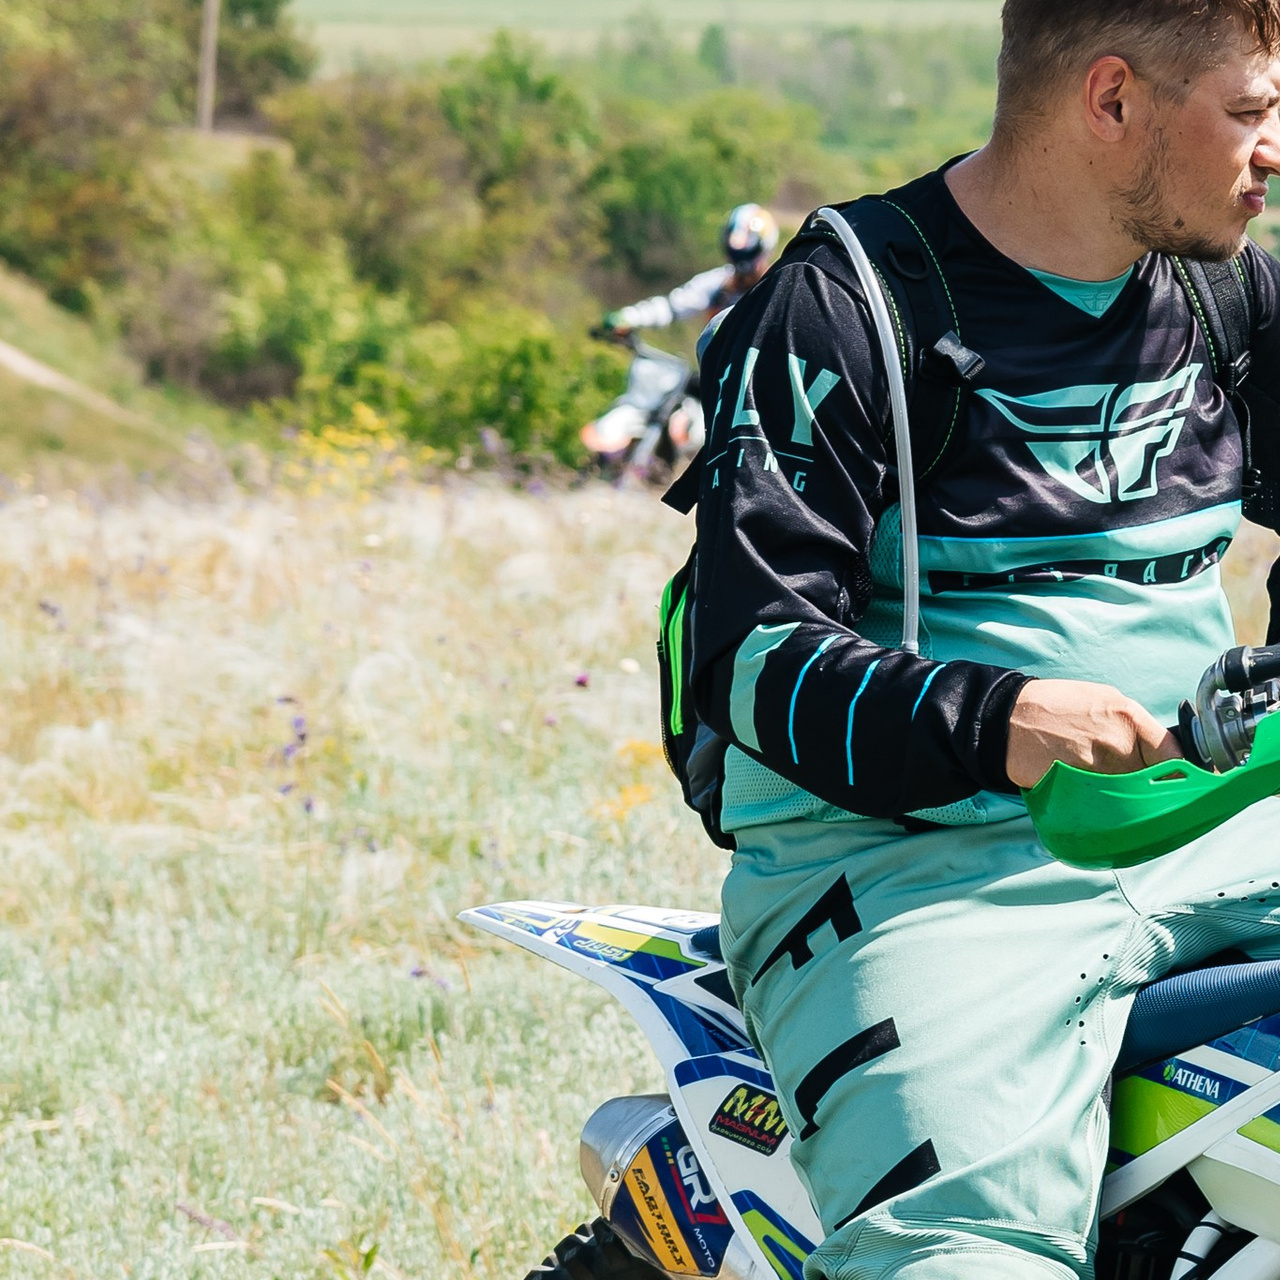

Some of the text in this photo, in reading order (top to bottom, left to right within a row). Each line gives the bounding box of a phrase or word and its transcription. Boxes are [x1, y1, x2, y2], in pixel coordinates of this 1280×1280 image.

[711, 448, 807, 493] AING
[1172, 1068, 1220, 1099] ATHENA
[715, 1113, 777, 1146] MAGNUM
[693, 1227, 716, 1269] MOTO
